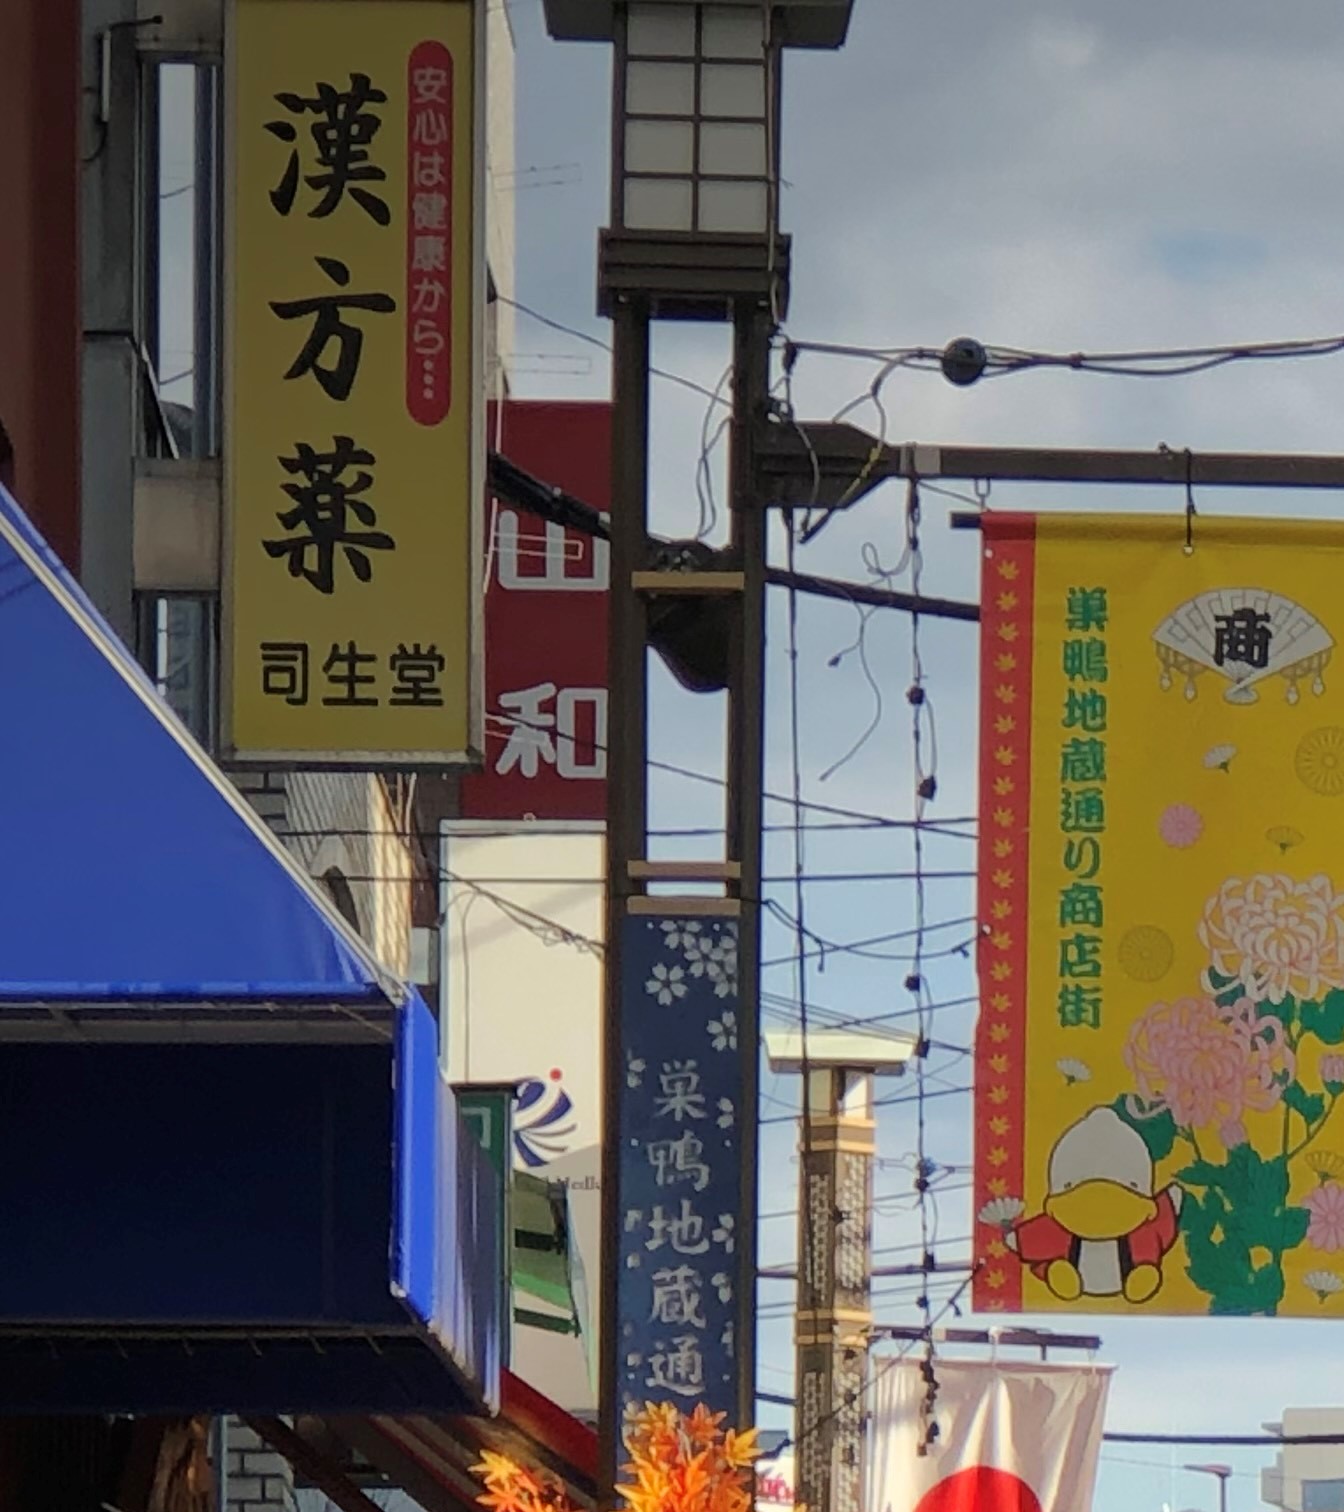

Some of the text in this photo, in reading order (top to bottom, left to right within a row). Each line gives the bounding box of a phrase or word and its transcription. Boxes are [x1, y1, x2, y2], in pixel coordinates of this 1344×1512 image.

[262, 72, 397, 595] 漢方薬
[260, 641, 446, 708] 司生堂
[1213, 607, 1271, 669] 商
[1057, 586, 1108, 1030] 巣鴨地蔵通り商店街
